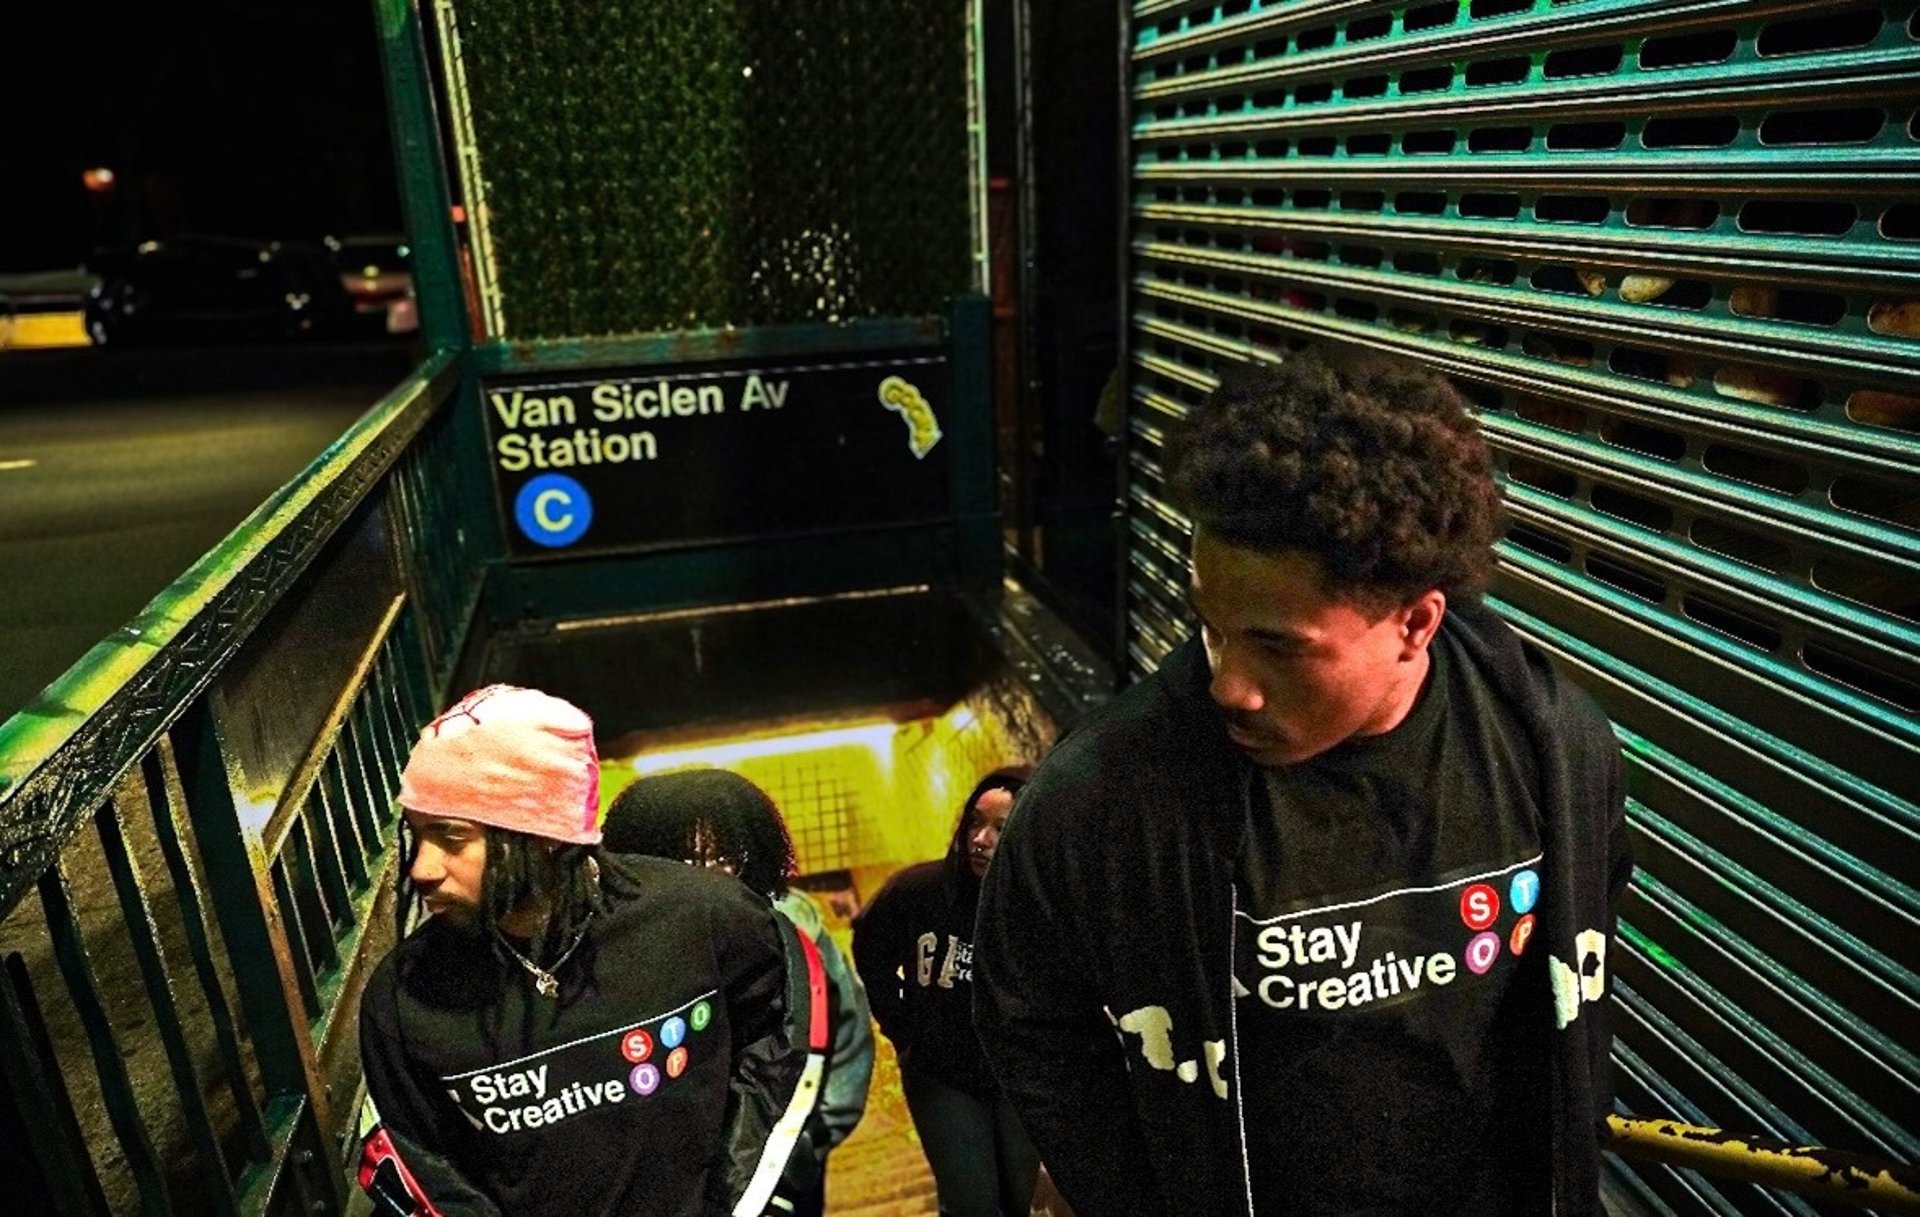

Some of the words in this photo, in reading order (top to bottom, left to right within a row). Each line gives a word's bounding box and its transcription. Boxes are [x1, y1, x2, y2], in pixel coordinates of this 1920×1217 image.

[492, 391, 576, 428] Van
[592, 380, 723, 421] Siclen
[741, 375, 788, 411] Av
[498, 429, 657, 471] Station
[534, 489, 572, 532] C
[1257, 921, 1362, 969] Stay
[1257, 950, 1457, 1010] Creative
[470, 1064, 548, 1105] Stay
[483, 1078, 626, 1134] Creative
